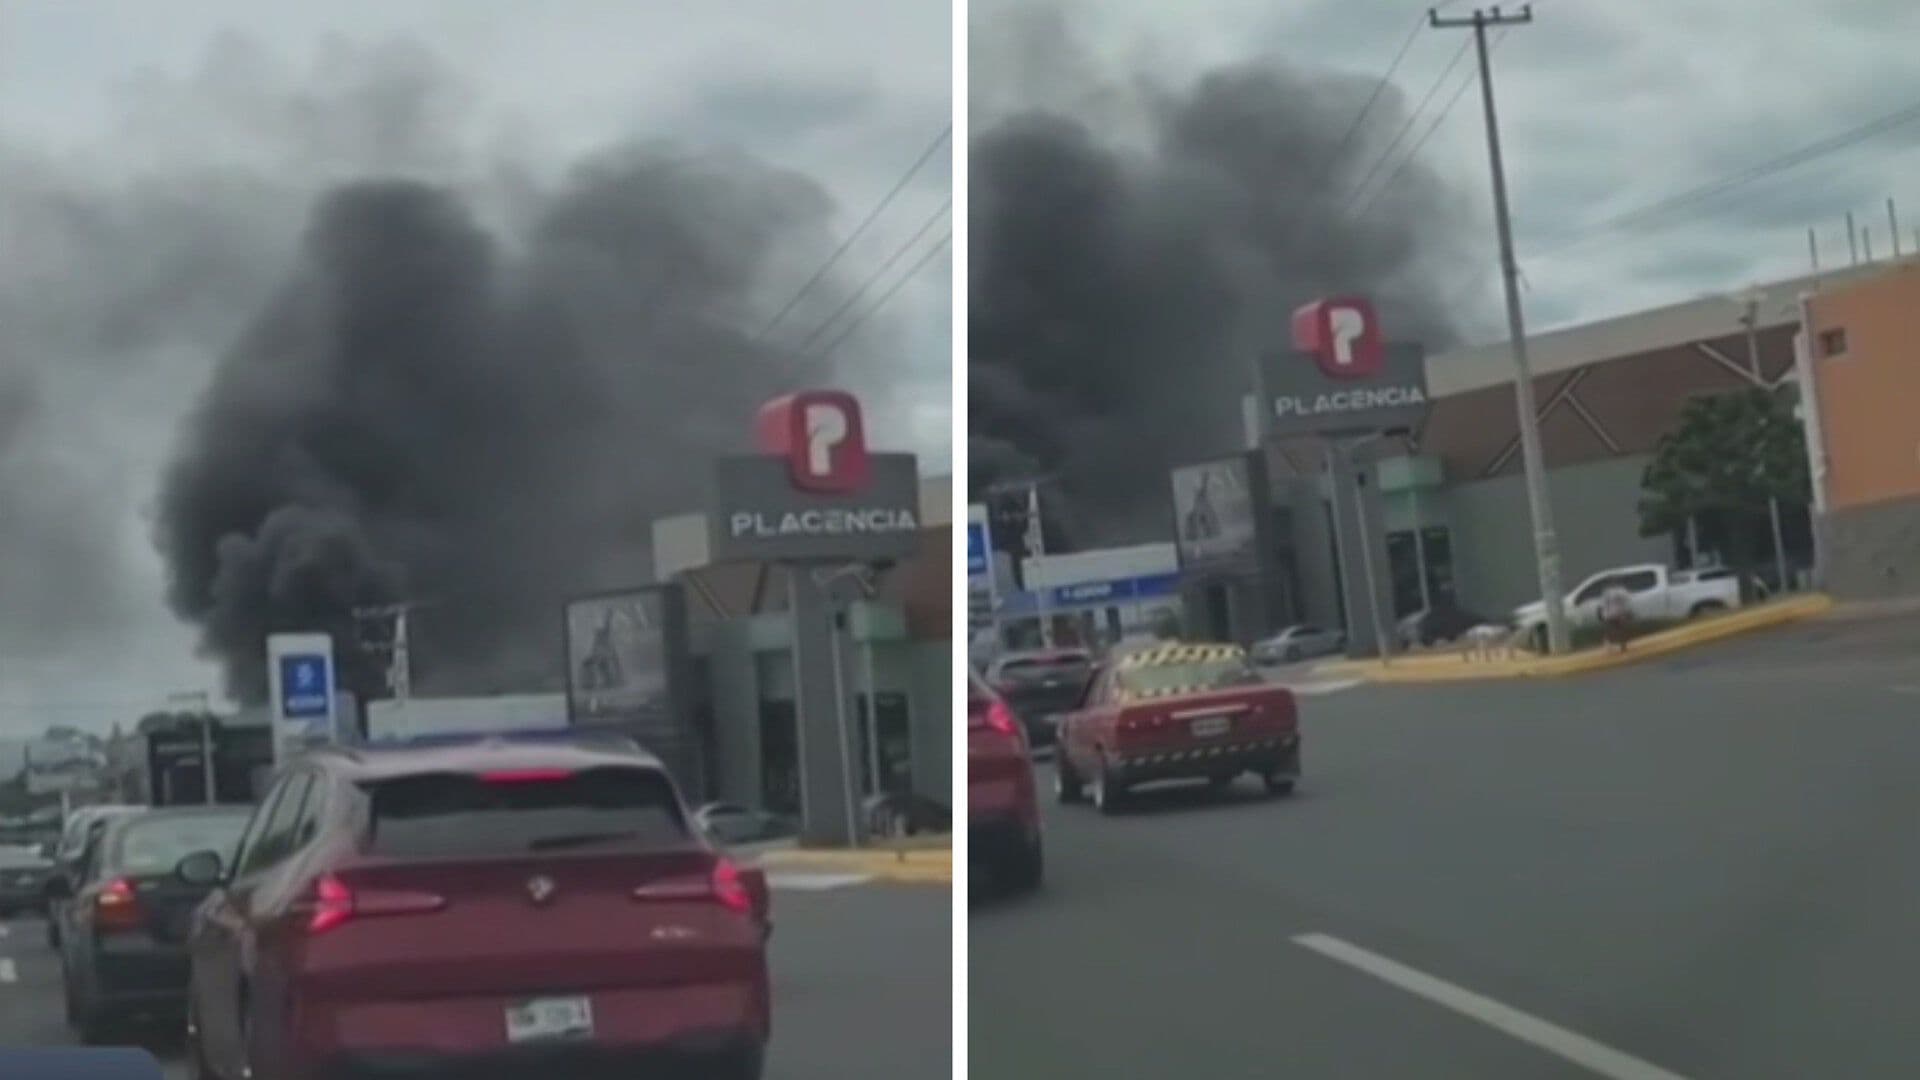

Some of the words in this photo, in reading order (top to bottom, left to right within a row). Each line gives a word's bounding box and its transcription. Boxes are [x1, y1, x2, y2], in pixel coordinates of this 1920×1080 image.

[1328, 307, 1364, 365] P
[1275, 386, 1425, 417] PLACENCIA
[806, 403, 846, 476] P
[730, 509, 916, 537] PLACENCIA
